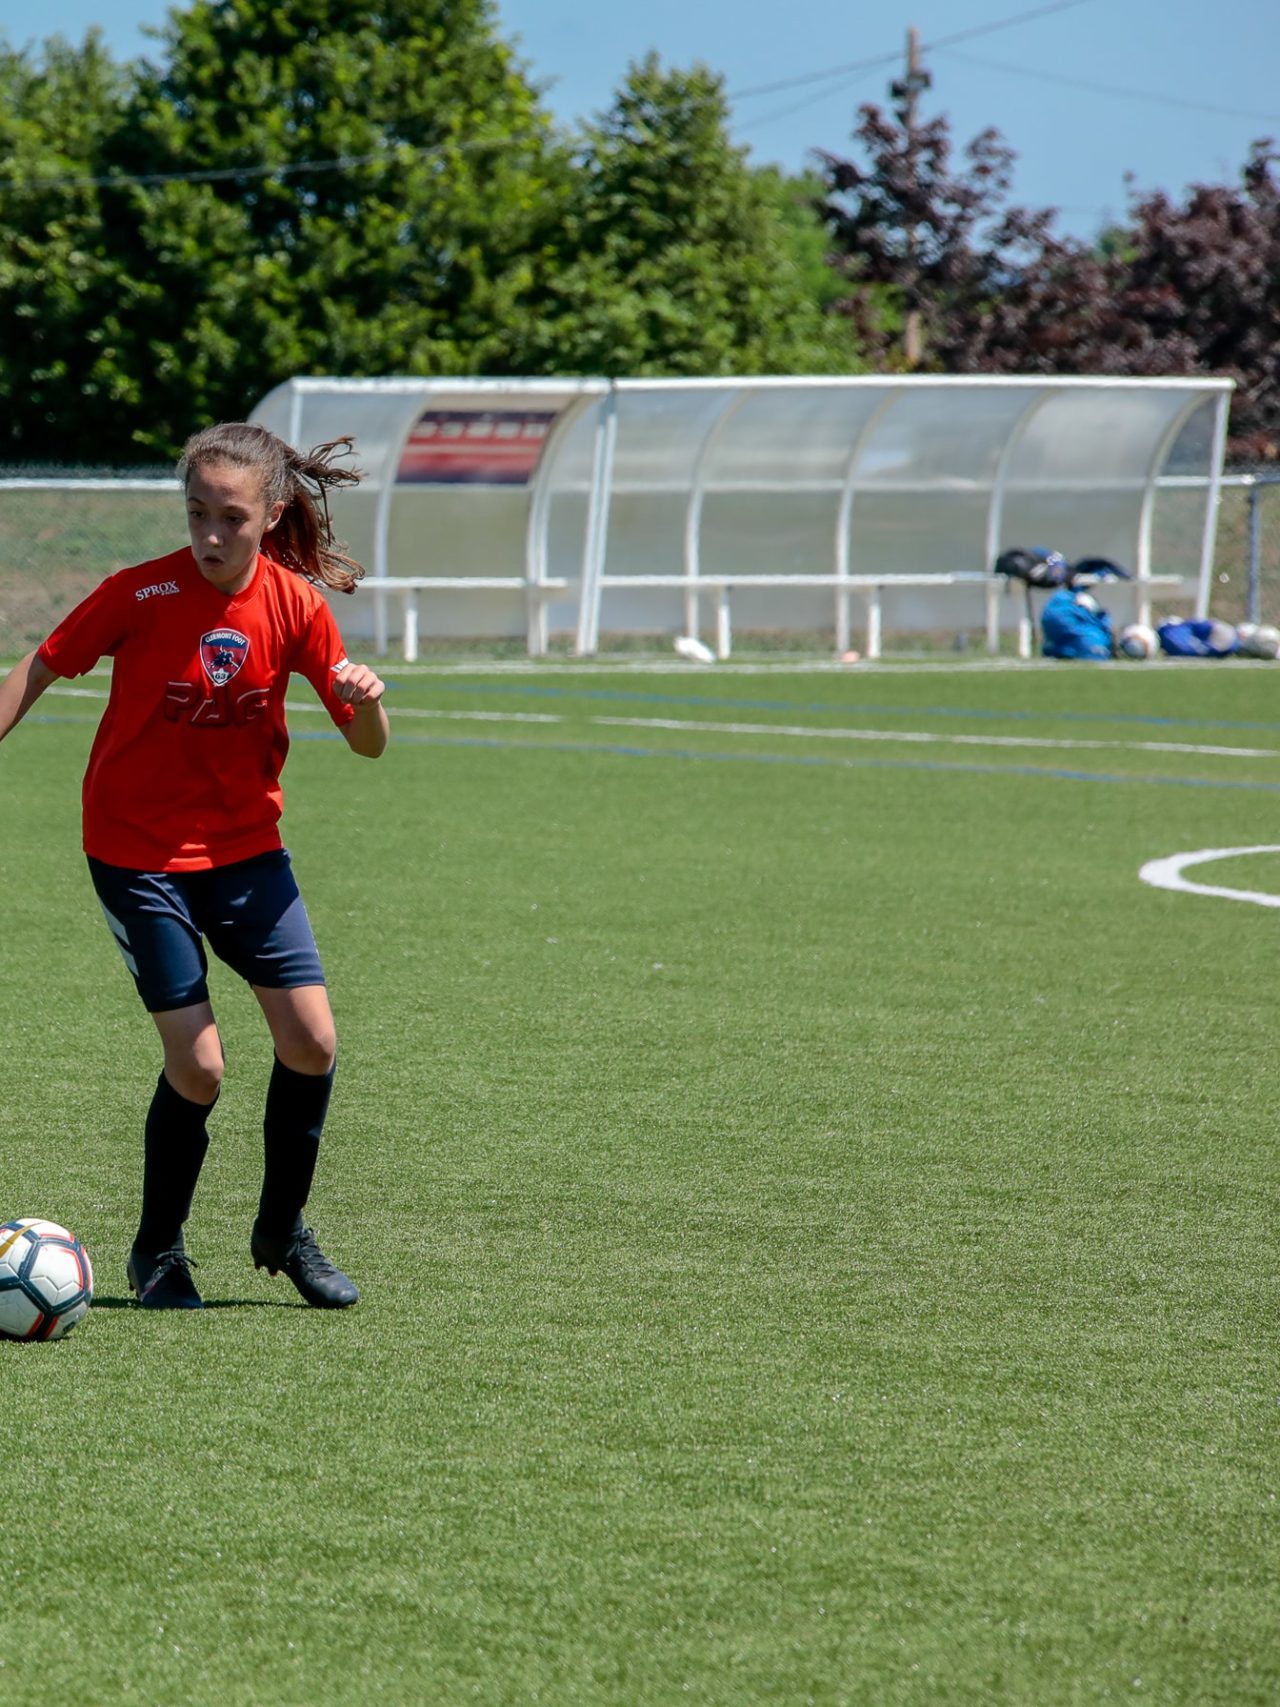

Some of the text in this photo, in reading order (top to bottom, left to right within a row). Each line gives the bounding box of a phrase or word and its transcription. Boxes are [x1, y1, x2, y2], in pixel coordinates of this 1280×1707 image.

[135, 580, 179, 601] SPROX
[205, 632, 246, 646] CLERMONT FOOT
